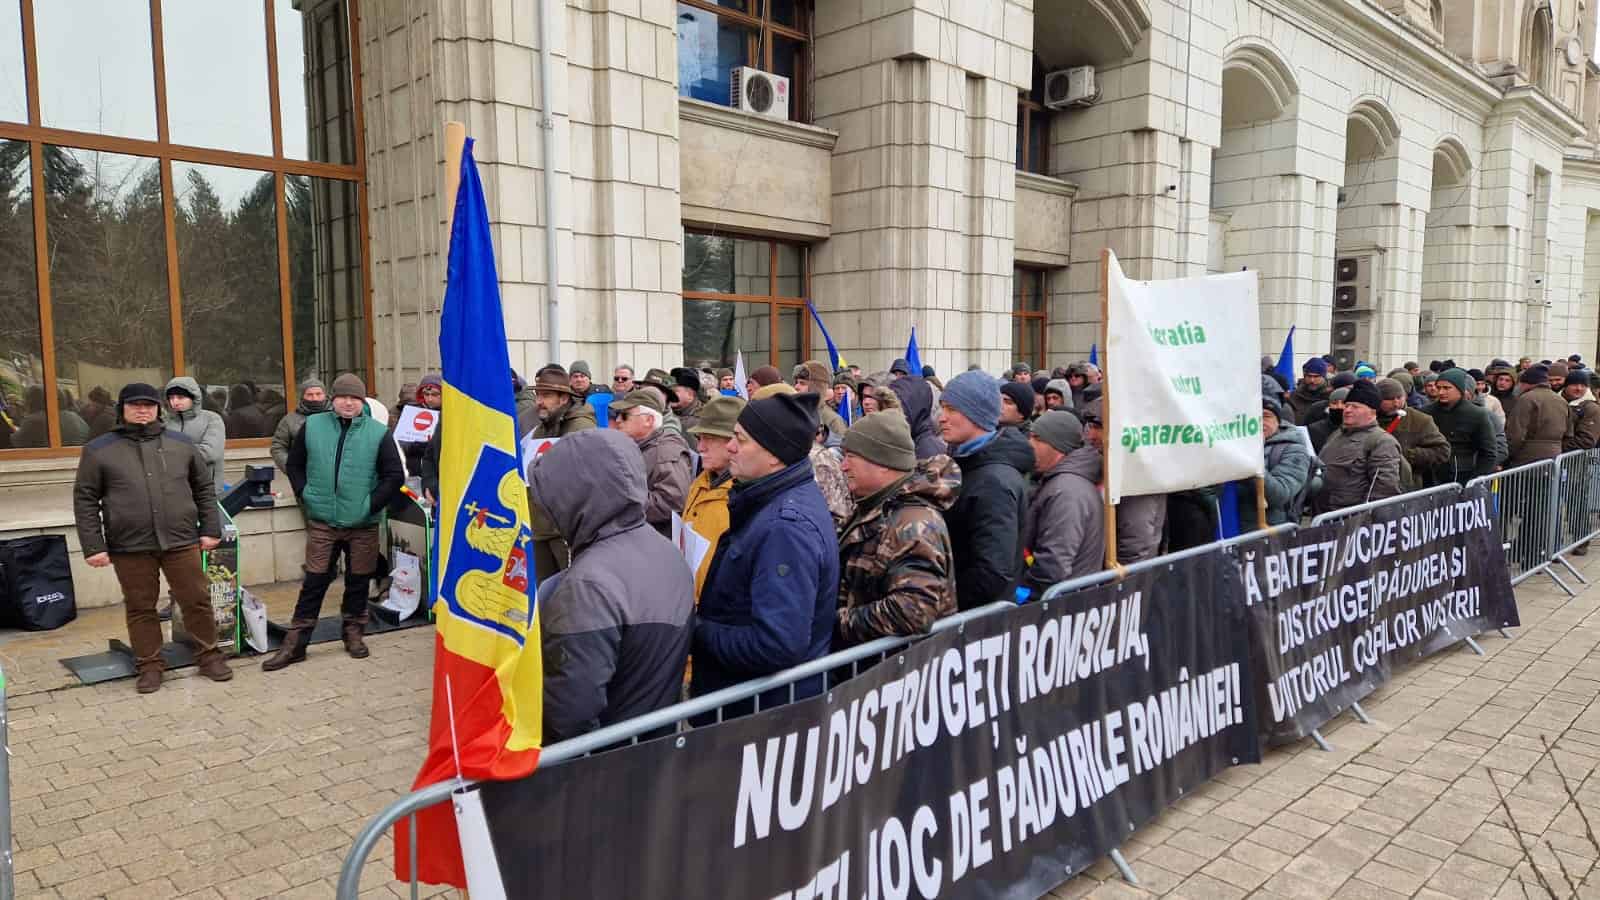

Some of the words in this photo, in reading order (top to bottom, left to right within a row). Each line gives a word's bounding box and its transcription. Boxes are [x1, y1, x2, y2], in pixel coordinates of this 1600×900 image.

[1121, 424, 1204, 453] apararea
[1238, 551, 1263, 606] Ă
[1264, 539, 1338, 598] BATEȚI
[1401, 497, 1492, 551] SILVICULTORI,
[1377, 552, 1448, 608] PĂDUREA
[1451, 546, 1467, 588] ȘI
[734, 726, 820, 849] NU
[822, 633, 1010, 812] DISTRUGEȚI
[1018, 592, 1151, 703] ROMSILVA,
[1267, 645, 1350, 723] VIITORUL
[1352, 609, 1422, 673] COPILOR
[862, 805, 942, 900] JOC
[950, 777, 993, 883] DE
[997, 735, 1130, 853] PĂDURILE
[1127, 662, 1243, 775] ROMÂNIEI!
